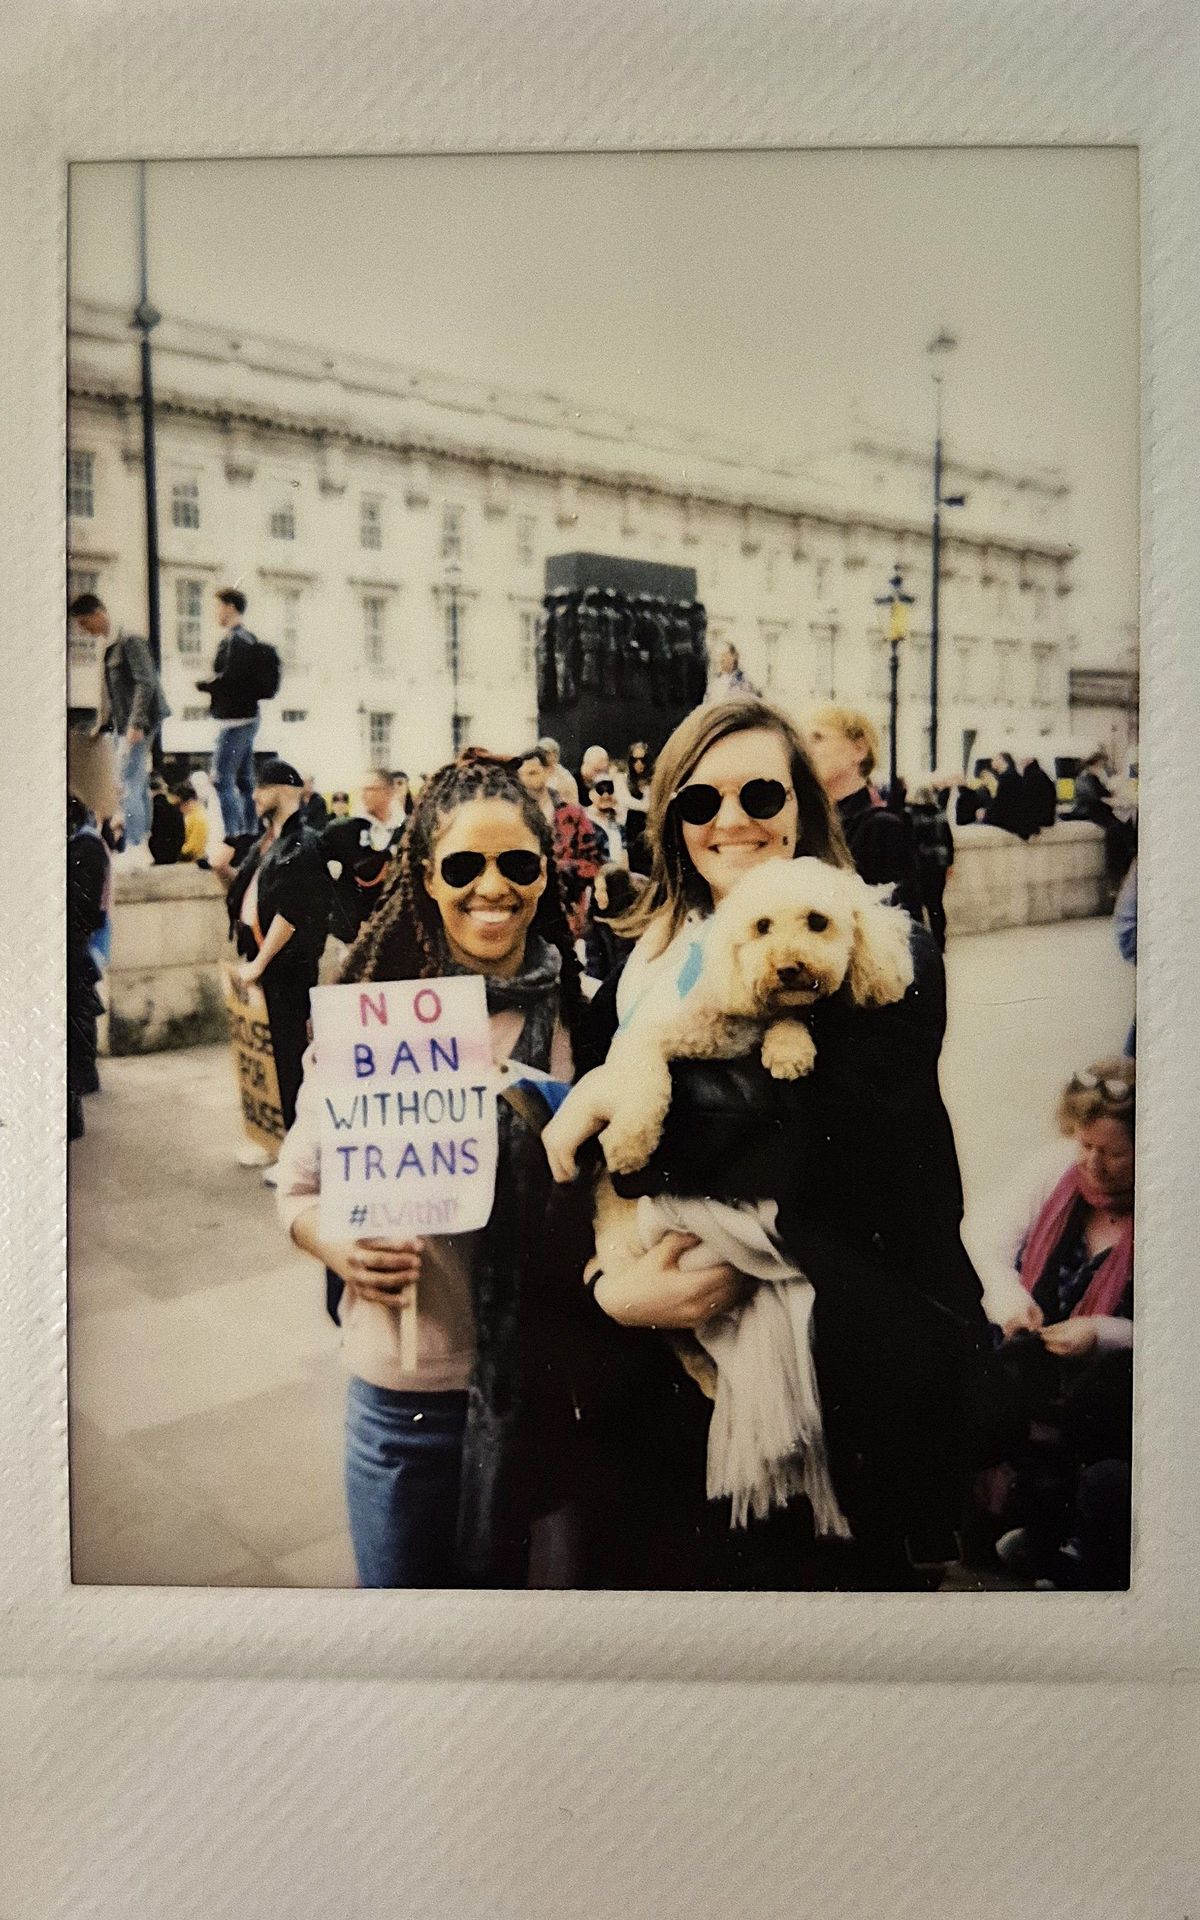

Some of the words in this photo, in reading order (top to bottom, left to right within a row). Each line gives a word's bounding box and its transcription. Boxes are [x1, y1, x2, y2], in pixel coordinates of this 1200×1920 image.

[359, 988, 442, 1027] NO
[353, 1037, 460, 1078] BAN
[325, 1086, 487, 1130] WITHOUT
[336, 1137, 479, 1181] TRANS
